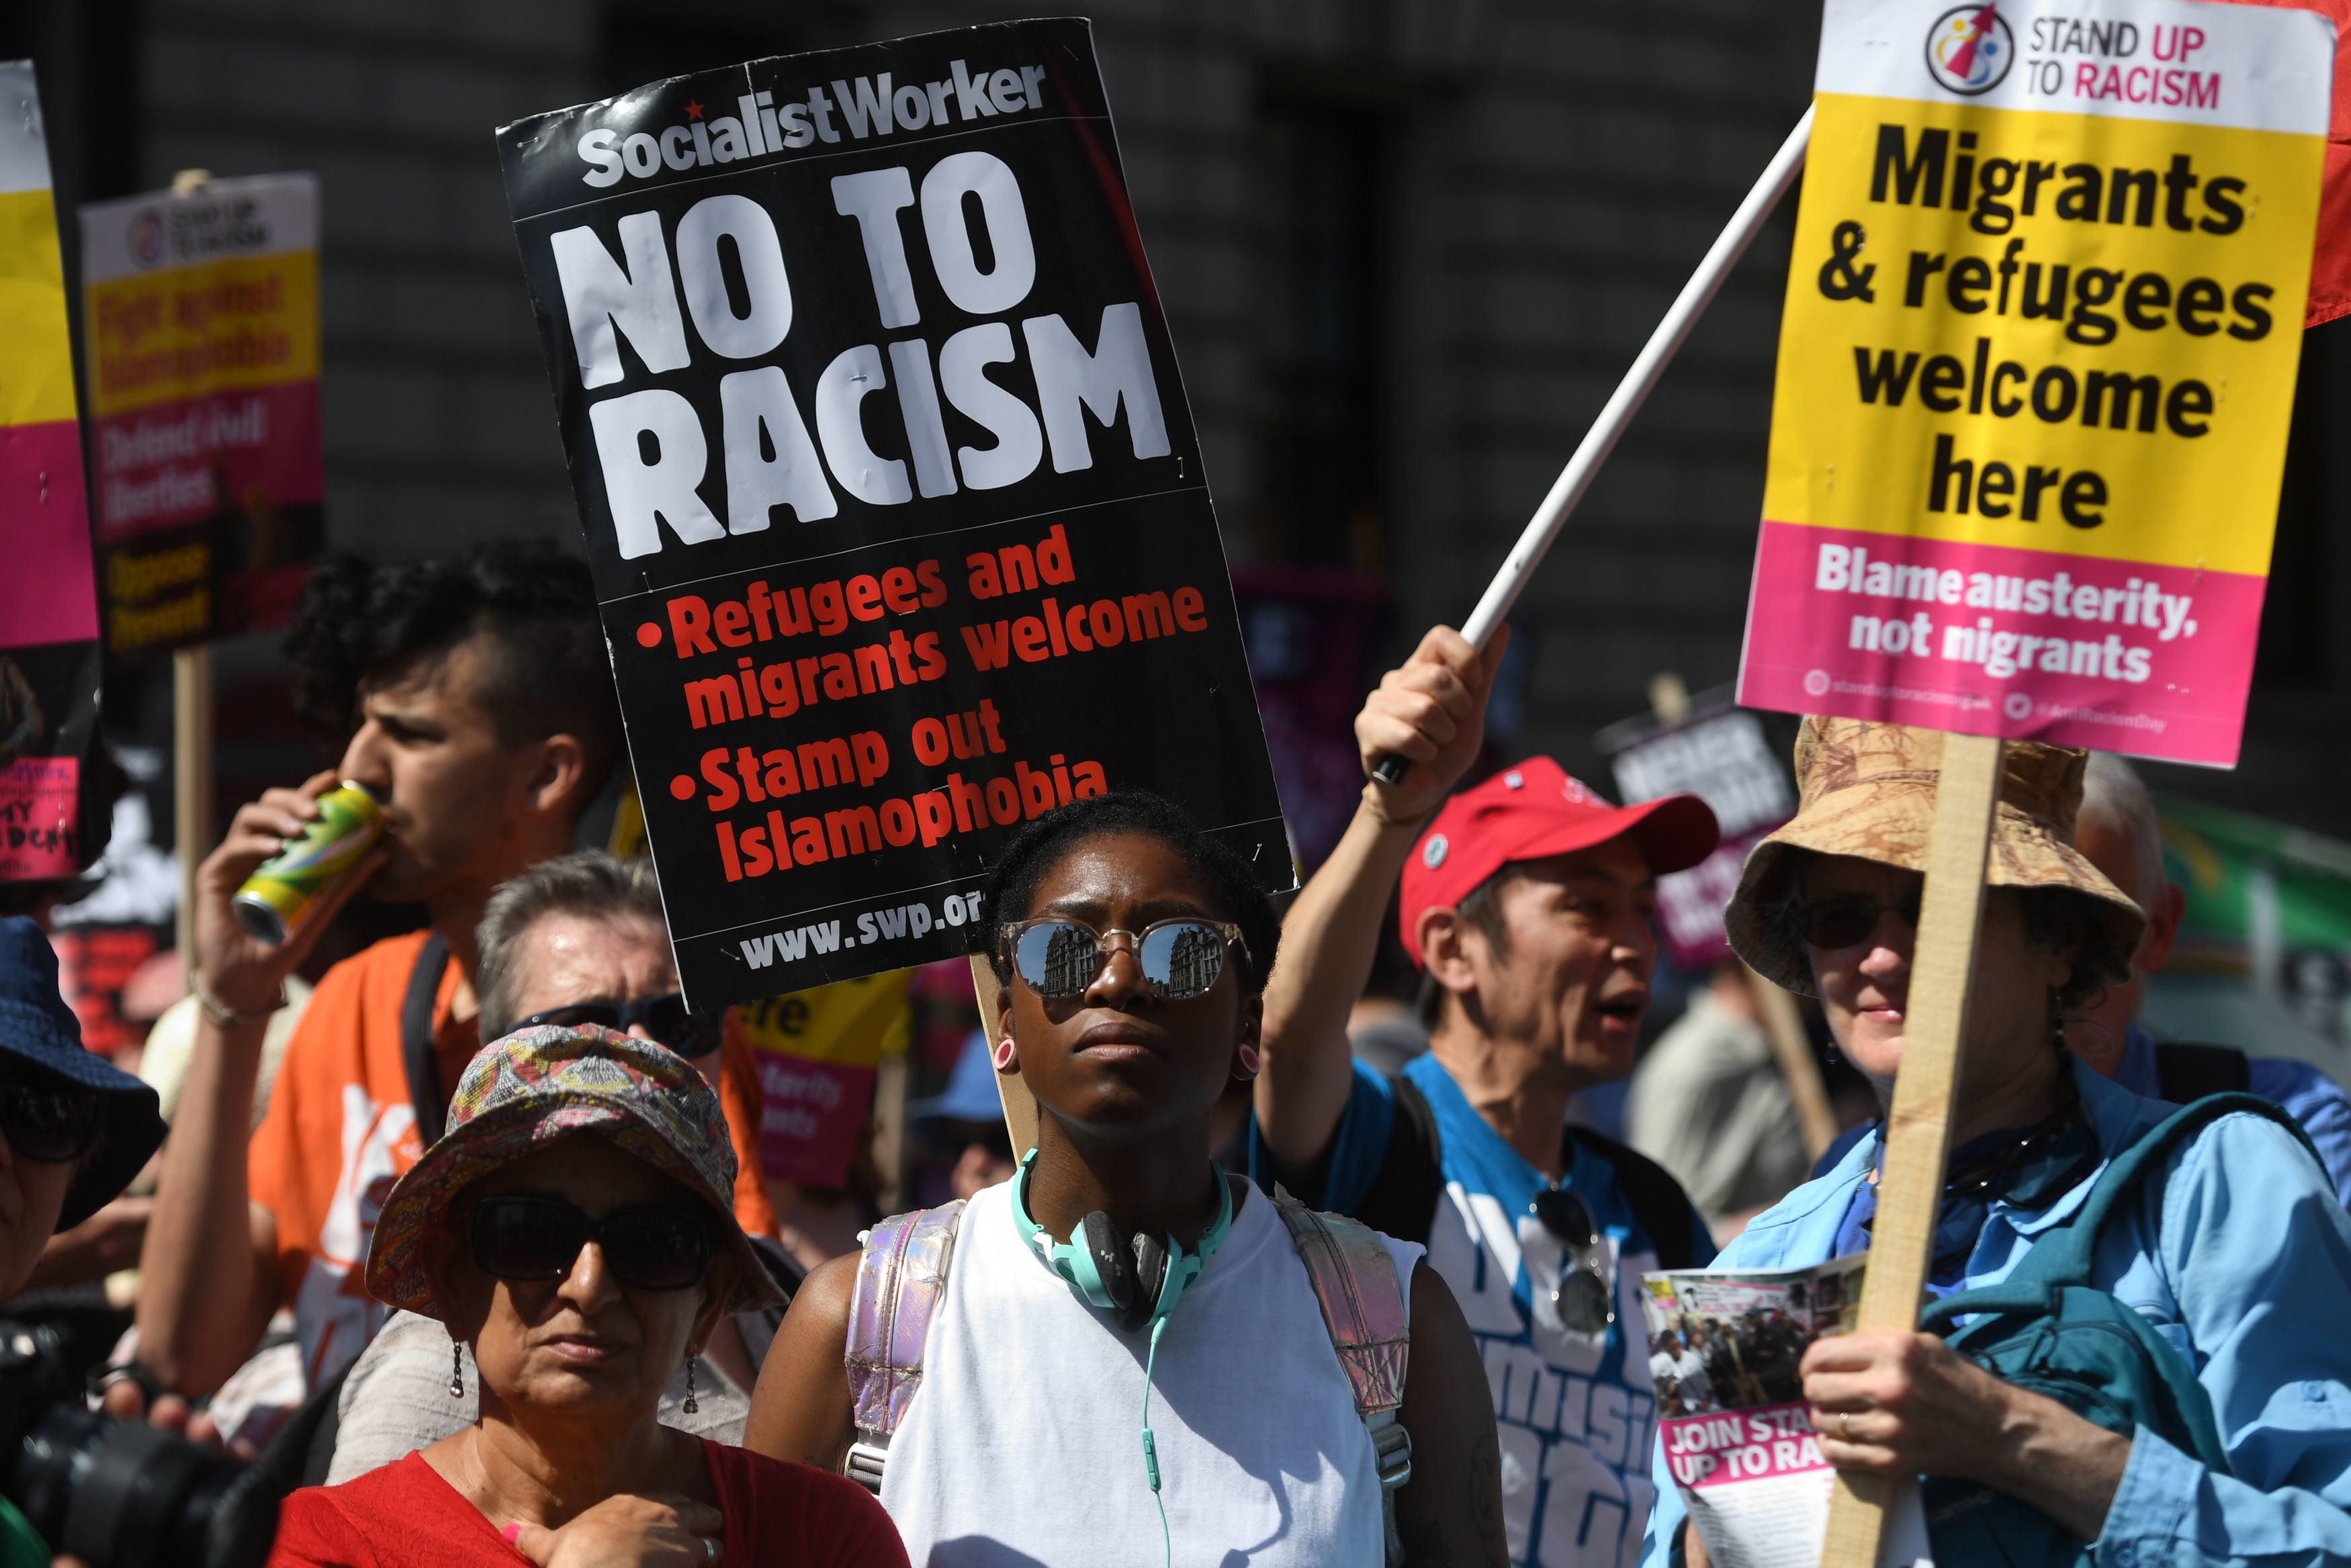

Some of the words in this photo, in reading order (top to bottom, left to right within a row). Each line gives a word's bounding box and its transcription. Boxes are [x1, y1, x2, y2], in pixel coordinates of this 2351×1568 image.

[2028, 60, 2064, 95] TO
[2074, 63, 2221, 110] RACISM
[2030, 17, 2139, 58] STAND
[2152, 25, 2206, 63] UP
[1869, 124, 2248, 237] Migrants
[549, 193, 794, 391] NO
[830, 150, 1037, 329] TO
[1818, 220, 1877, 304] &
[1903, 238, 2276, 347] refugees
[588, 301, 1172, 561] RACISM
[1853, 337, 2215, 440] welcome
[1927, 432, 2110, 530] here
[666, 559, 948, 659] Refugees
[965, 523, 1076, 600] and
[1815, 543, 1963, 605] Blame
[1965, 569, 2199, 642] austerity,
[683, 629, 947, 729] migrants
[960, 586, 1208, 672] welcome
[1849, 612, 1934, 658] not
[1941, 616, 2152, 683] migrants
[700, 730, 890, 812] Stamp
[911, 698, 1008, 767] out
[715, 753, 1109, 884] Islamophobia
[739, 890, 986, 970] www.swp.or
[1669, 1416, 1745, 1455] JOIN
[1748, 1407, 1813, 1442] STA
[1672, 1454, 1717, 1486] UP
[1721, 1444, 1770, 1479] TO
[1772, 1435, 1826, 1472] RA
